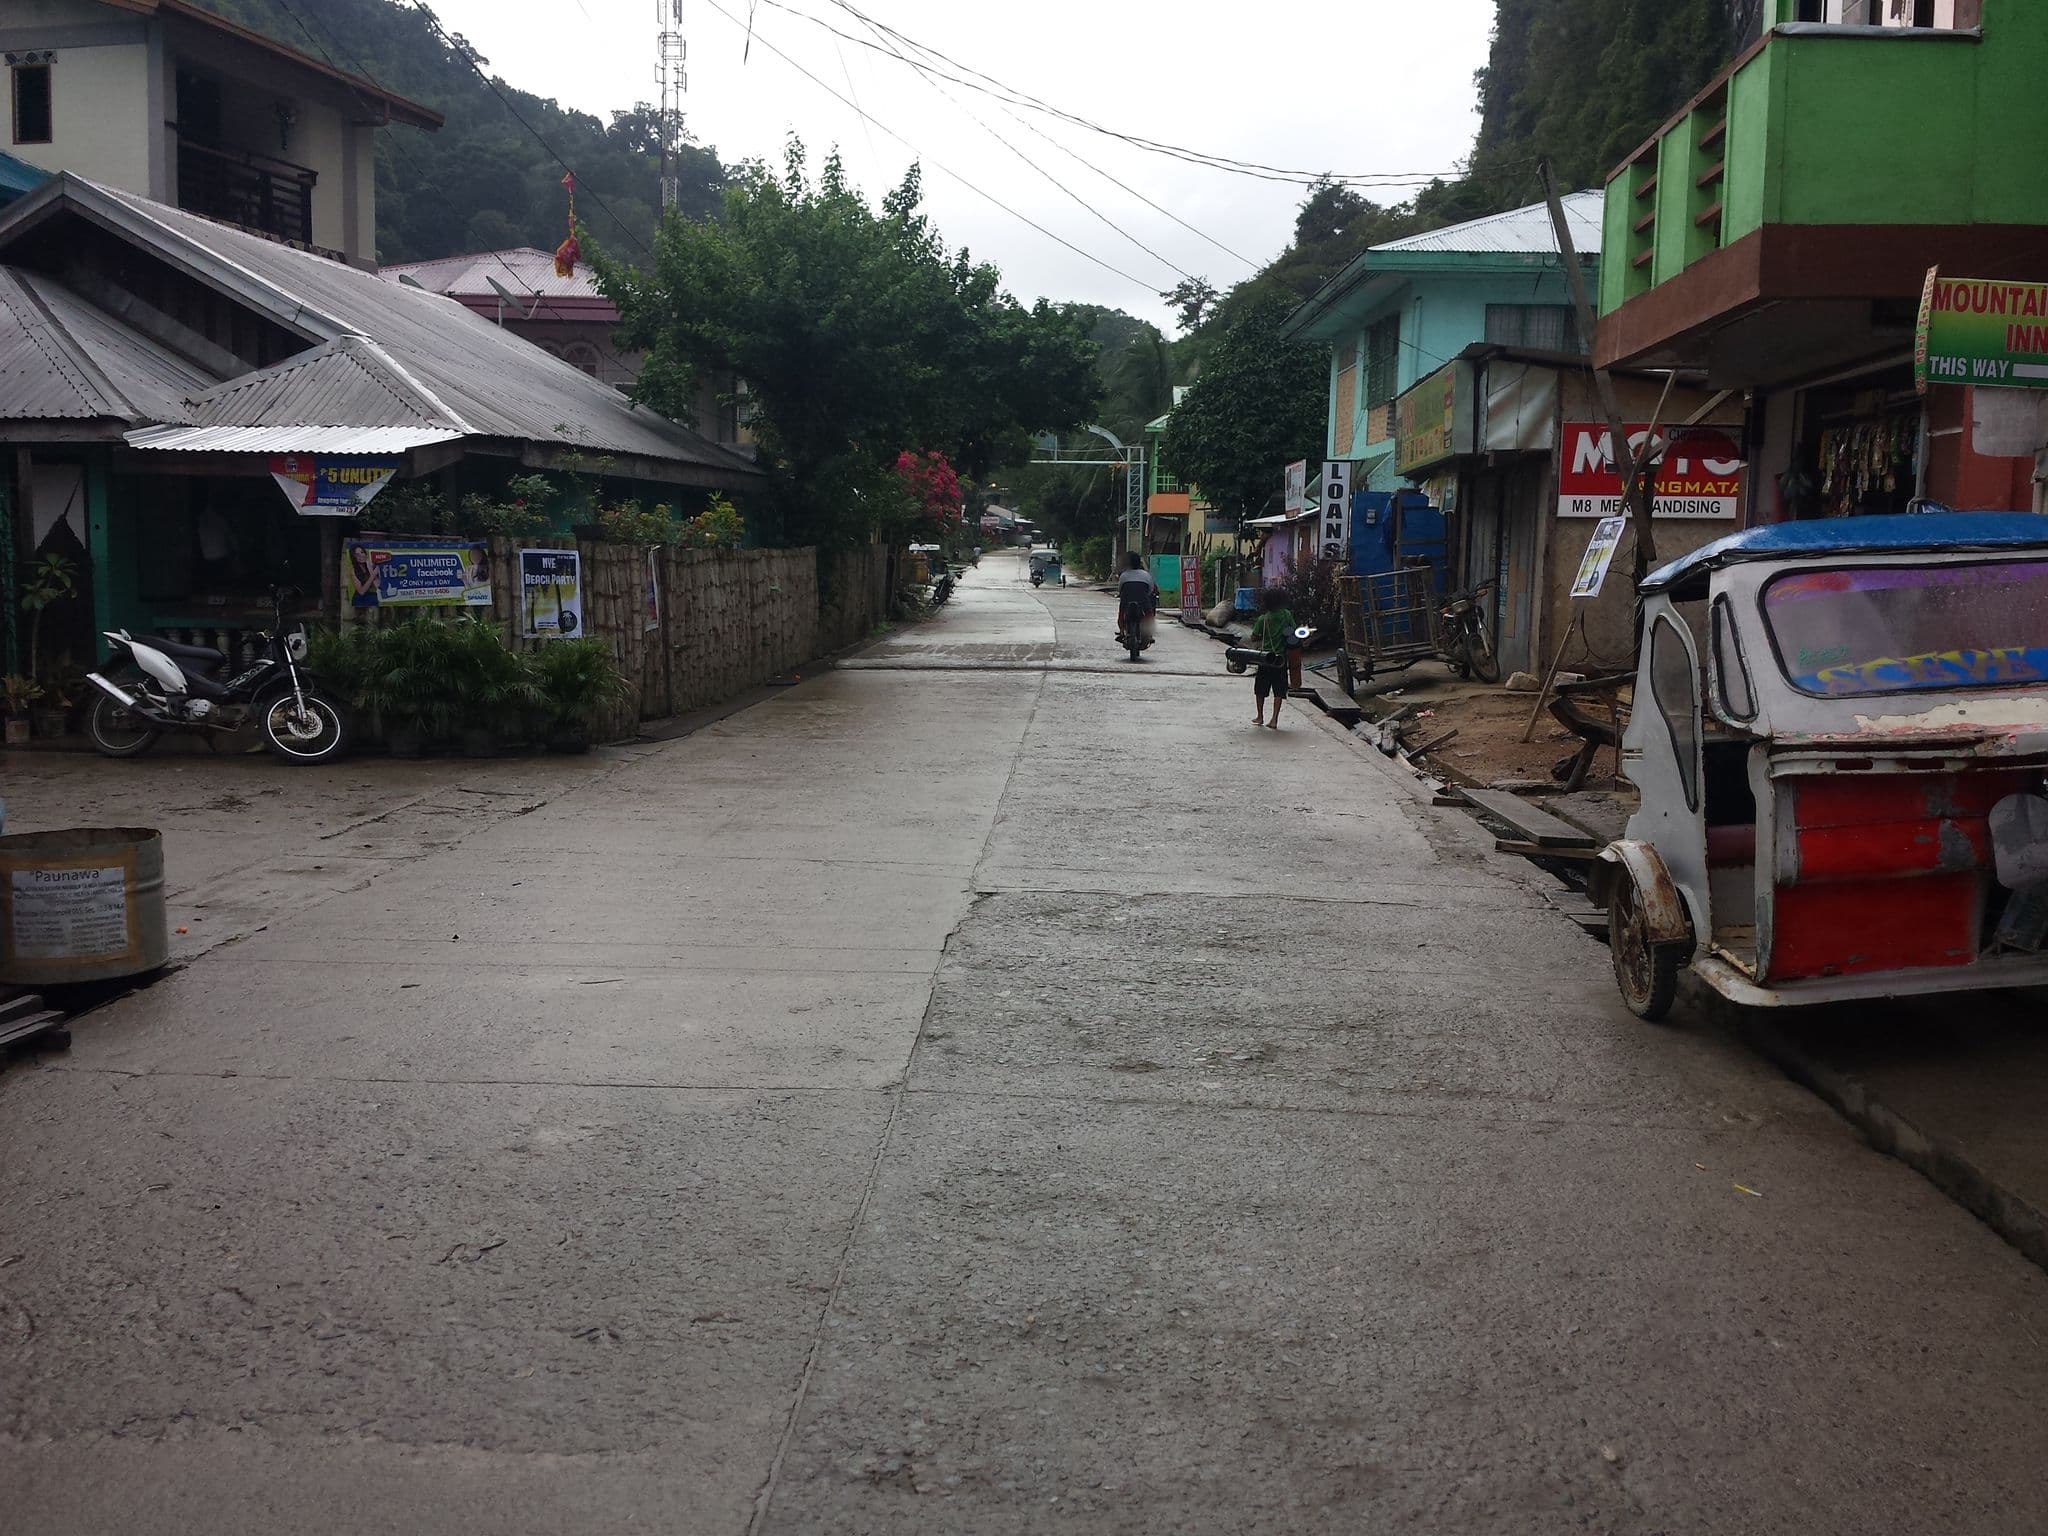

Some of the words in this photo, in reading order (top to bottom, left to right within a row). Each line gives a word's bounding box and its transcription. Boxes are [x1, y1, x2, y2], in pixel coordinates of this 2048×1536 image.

[2006, 323, 2048, 354] INN
[1929, 355, 1967, 377] THIS
[1972, 358, 2010, 378] WAY
[1325, 463, 1344, 559] LOANS
[1572, 499, 1592, 513] M8
[1601, 499, 1721, 514] MERANDISING
[410, 558, 457, 568] UNLIMITED
[542, 557, 557, 569] NYE
[382, 564, 408, 578] fb2
[417, 568, 454, 577] facebook
[525, 573, 551, 585] BEACH
[551, 573, 576, 585] PARTY
